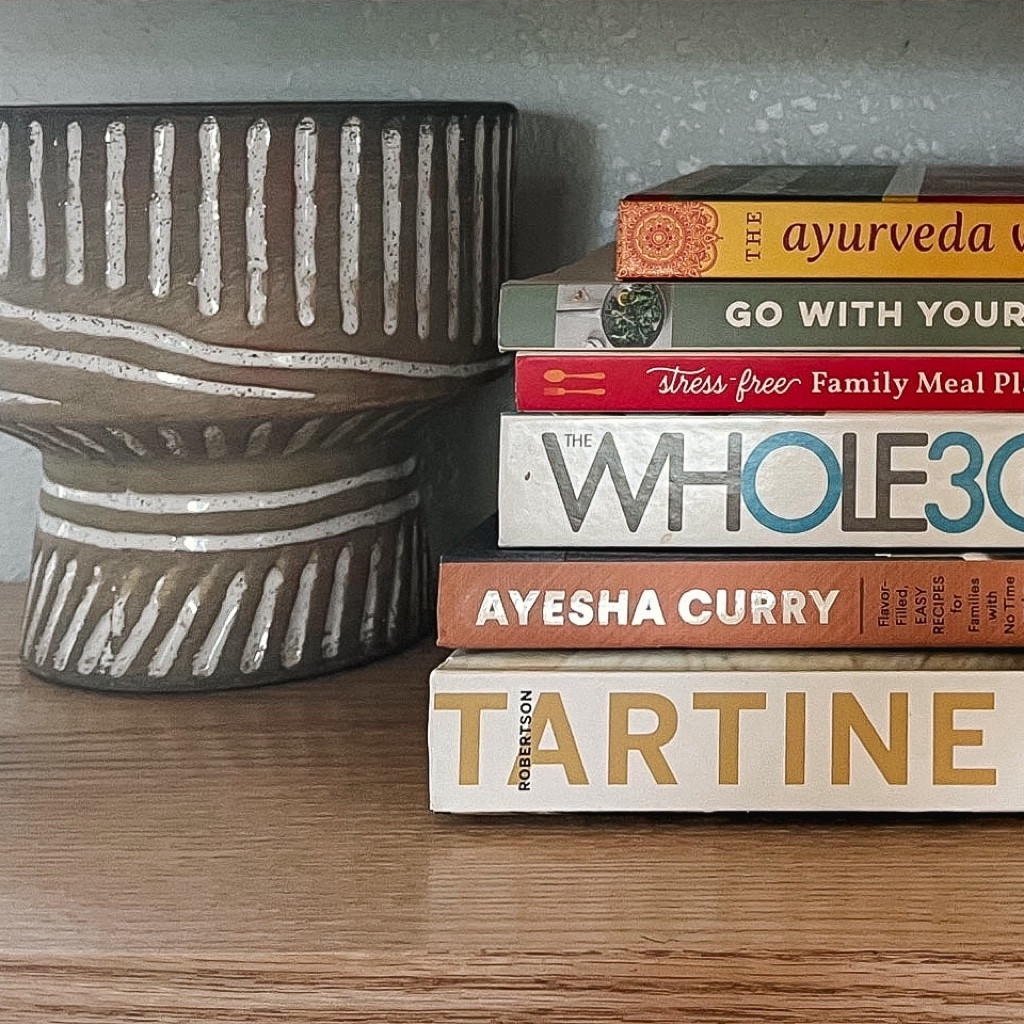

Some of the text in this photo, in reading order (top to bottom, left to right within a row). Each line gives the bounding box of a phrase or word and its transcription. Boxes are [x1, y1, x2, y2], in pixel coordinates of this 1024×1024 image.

[745, 211, 762, 262] THE
[782, 211, 995, 263] ayurveda
[725, 301, 783, 327] GO
[798, 301, 902, 327] WITH
[646, 366, 802, 402] stress-free
[811, 371, 909, 400] Family
[916, 371, 984, 394] Meal
[564, 433, 592, 448] THE
[475, 589, 840, 626] AYESHA CURRY
[878, 580, 890, 627] Flavor-
[896, 585, 909, 626] Filled,
[915, 586, 927, 624] EASY
[933, 576, 945, 634] RECIPES
[950, 594, 962, 613] for
[968, 577, 980, 632] Families
[986, 591, 998, 620] with
[1004, 576, 1015, 634] No Time
[433, 691, 997, 786] TARTINE
[518, 689, 533, 792] ROBERTSON
